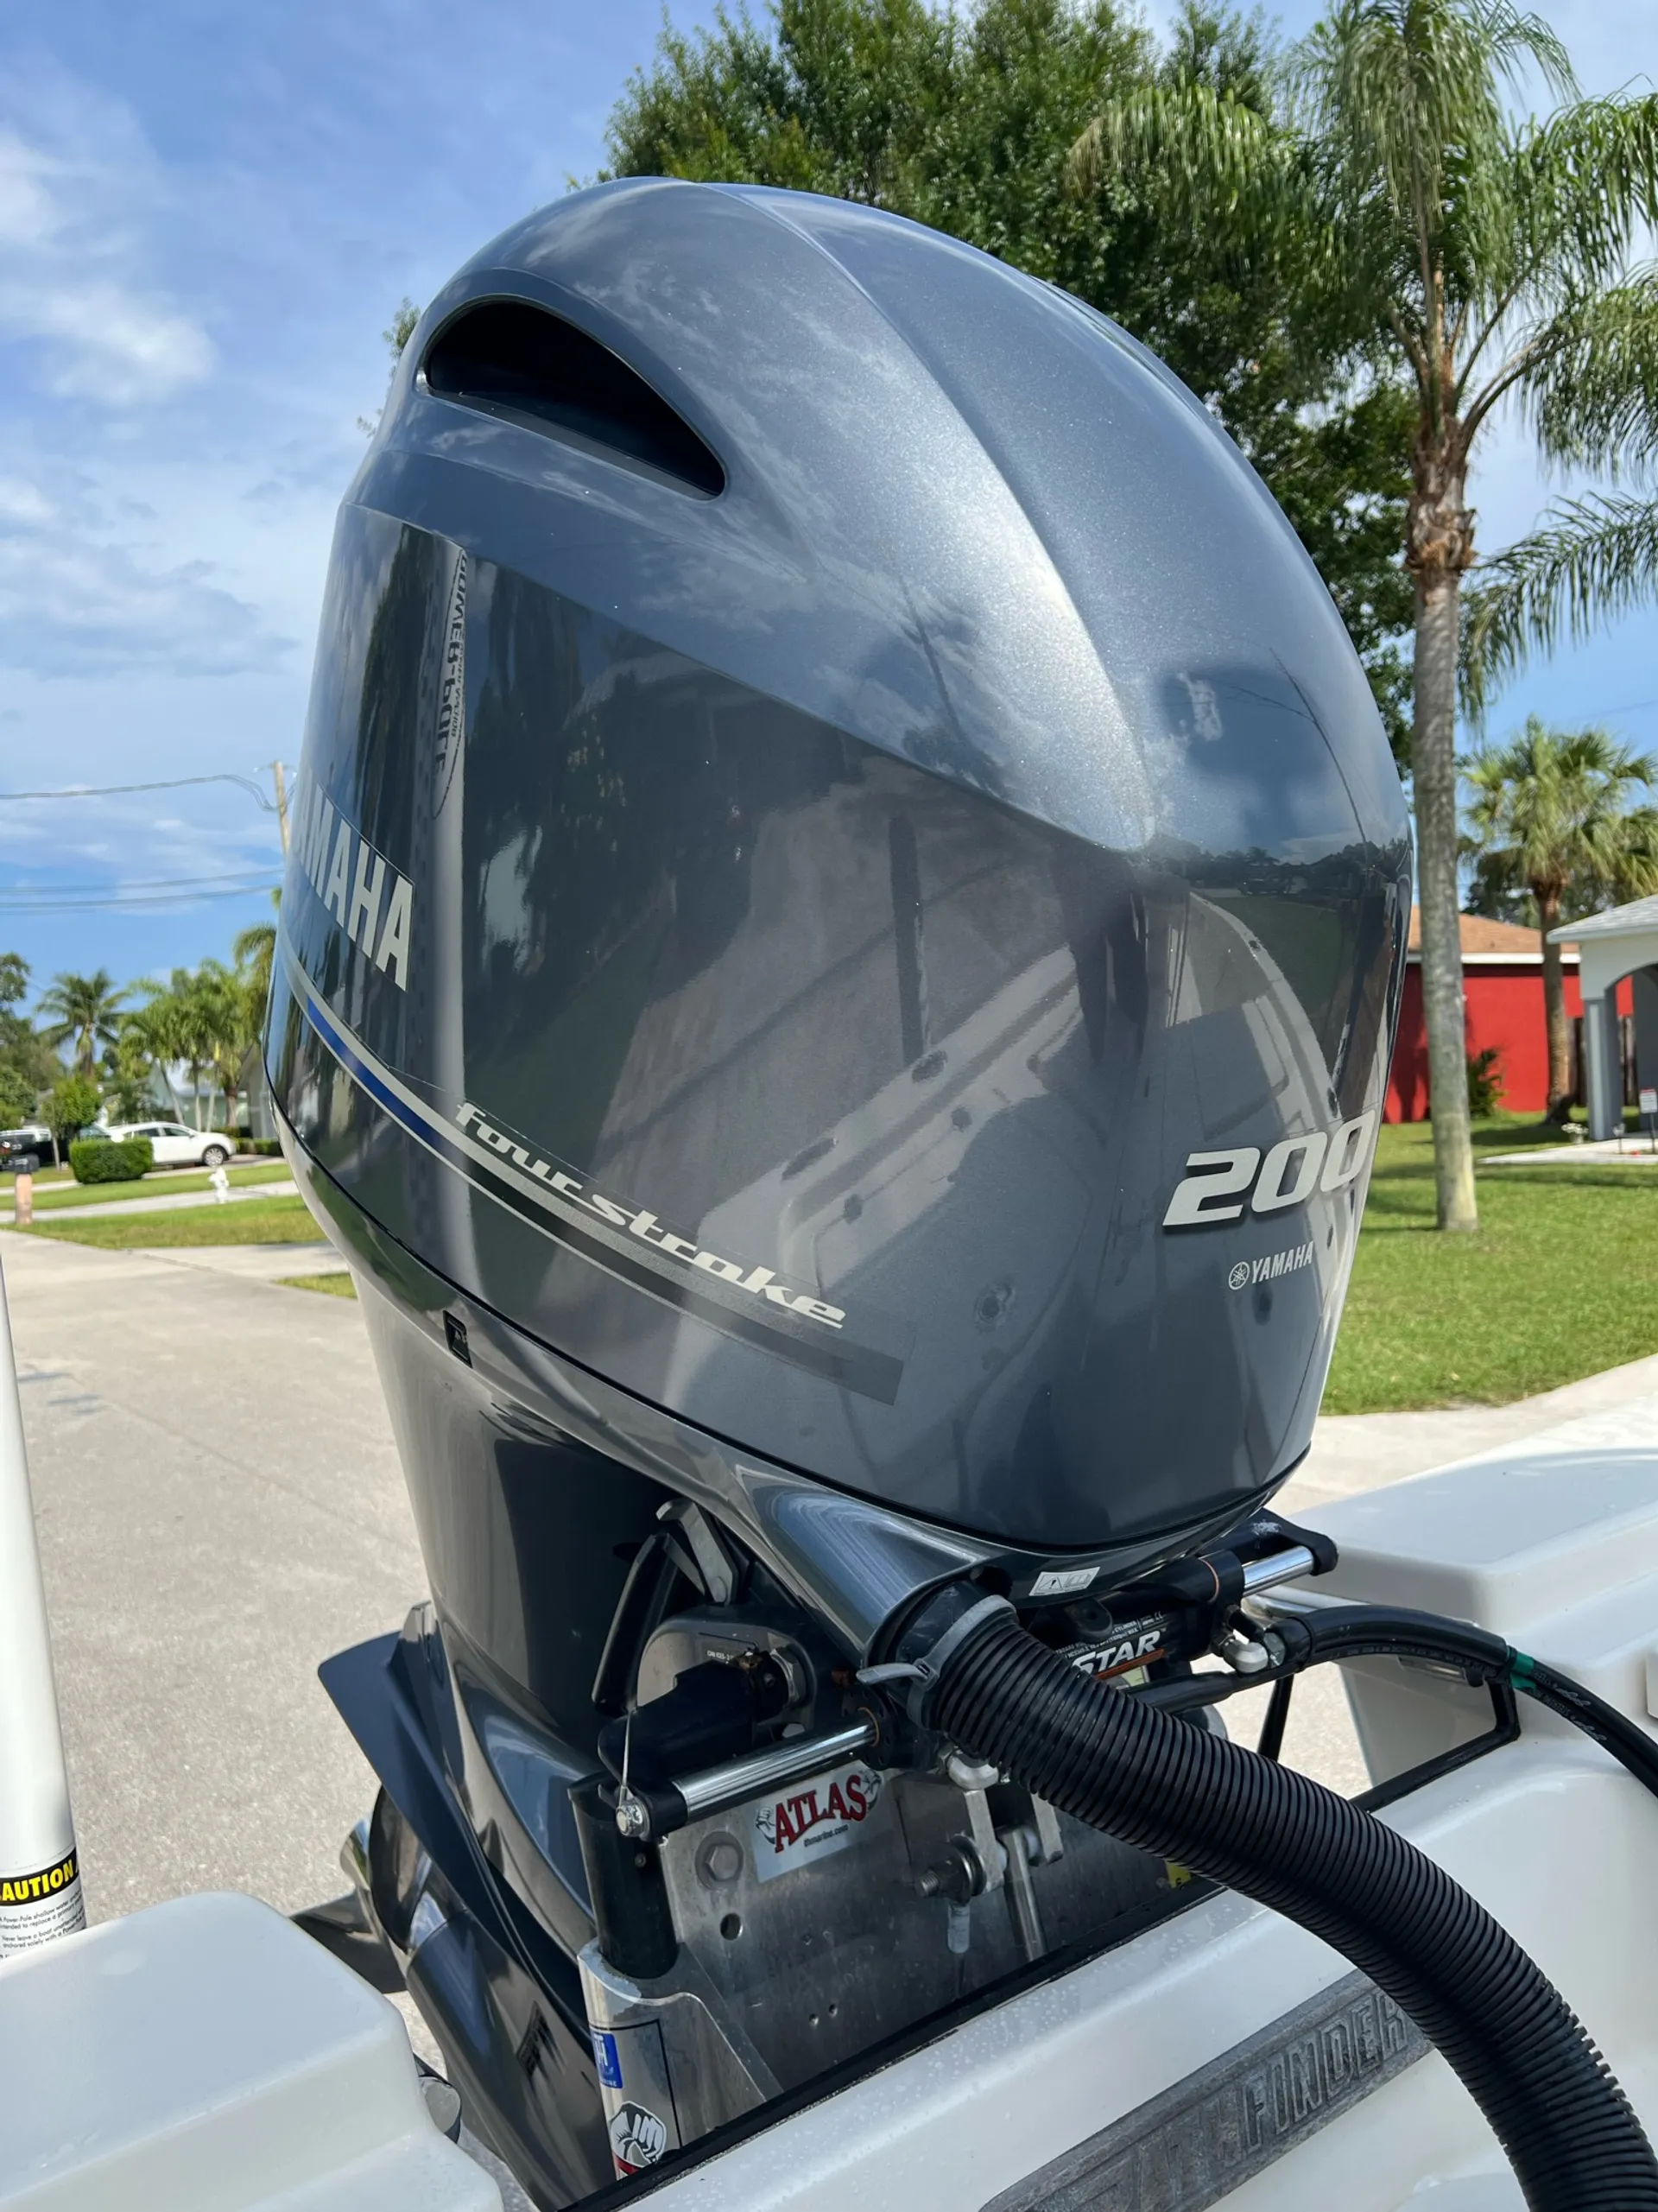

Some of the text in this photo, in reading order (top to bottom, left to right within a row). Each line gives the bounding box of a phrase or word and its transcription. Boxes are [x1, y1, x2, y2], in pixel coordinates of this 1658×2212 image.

[293, 763, 414, 992] AMAHA
[1162, 1110, 1376, 1226] 200
[1251, 1241, 1314, 1283] YAMAHA
[774, 1773, 868, 1854] ATLAS
[0, 1859, 74, 1903] AUTION
